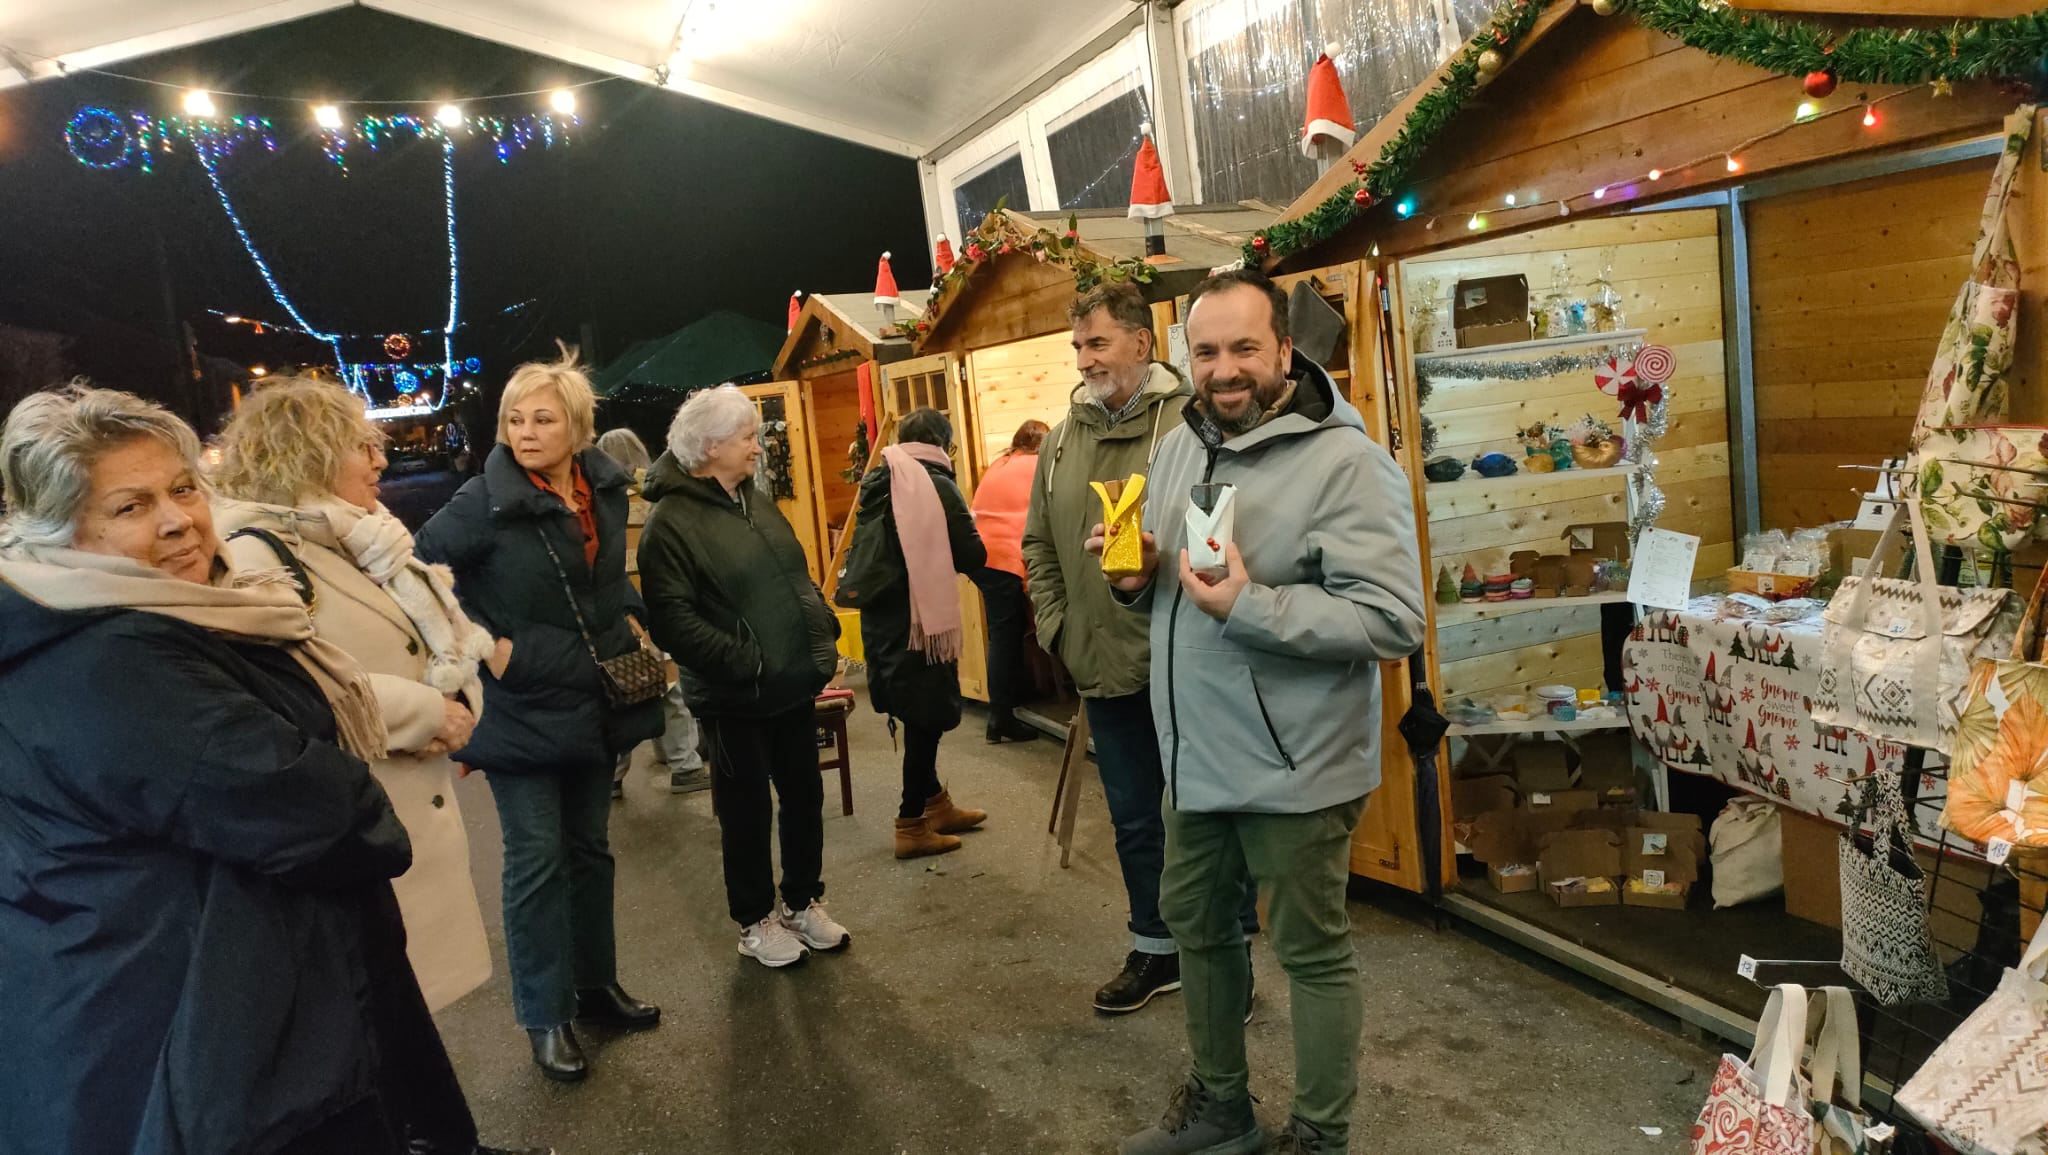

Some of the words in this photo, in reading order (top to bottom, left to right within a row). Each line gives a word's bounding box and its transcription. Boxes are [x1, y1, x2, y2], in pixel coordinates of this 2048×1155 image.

[1661, 663, 1675, 672] no
[1674, 674, 1691, 689] like
[1765, 701, 1796, 714] sweet
